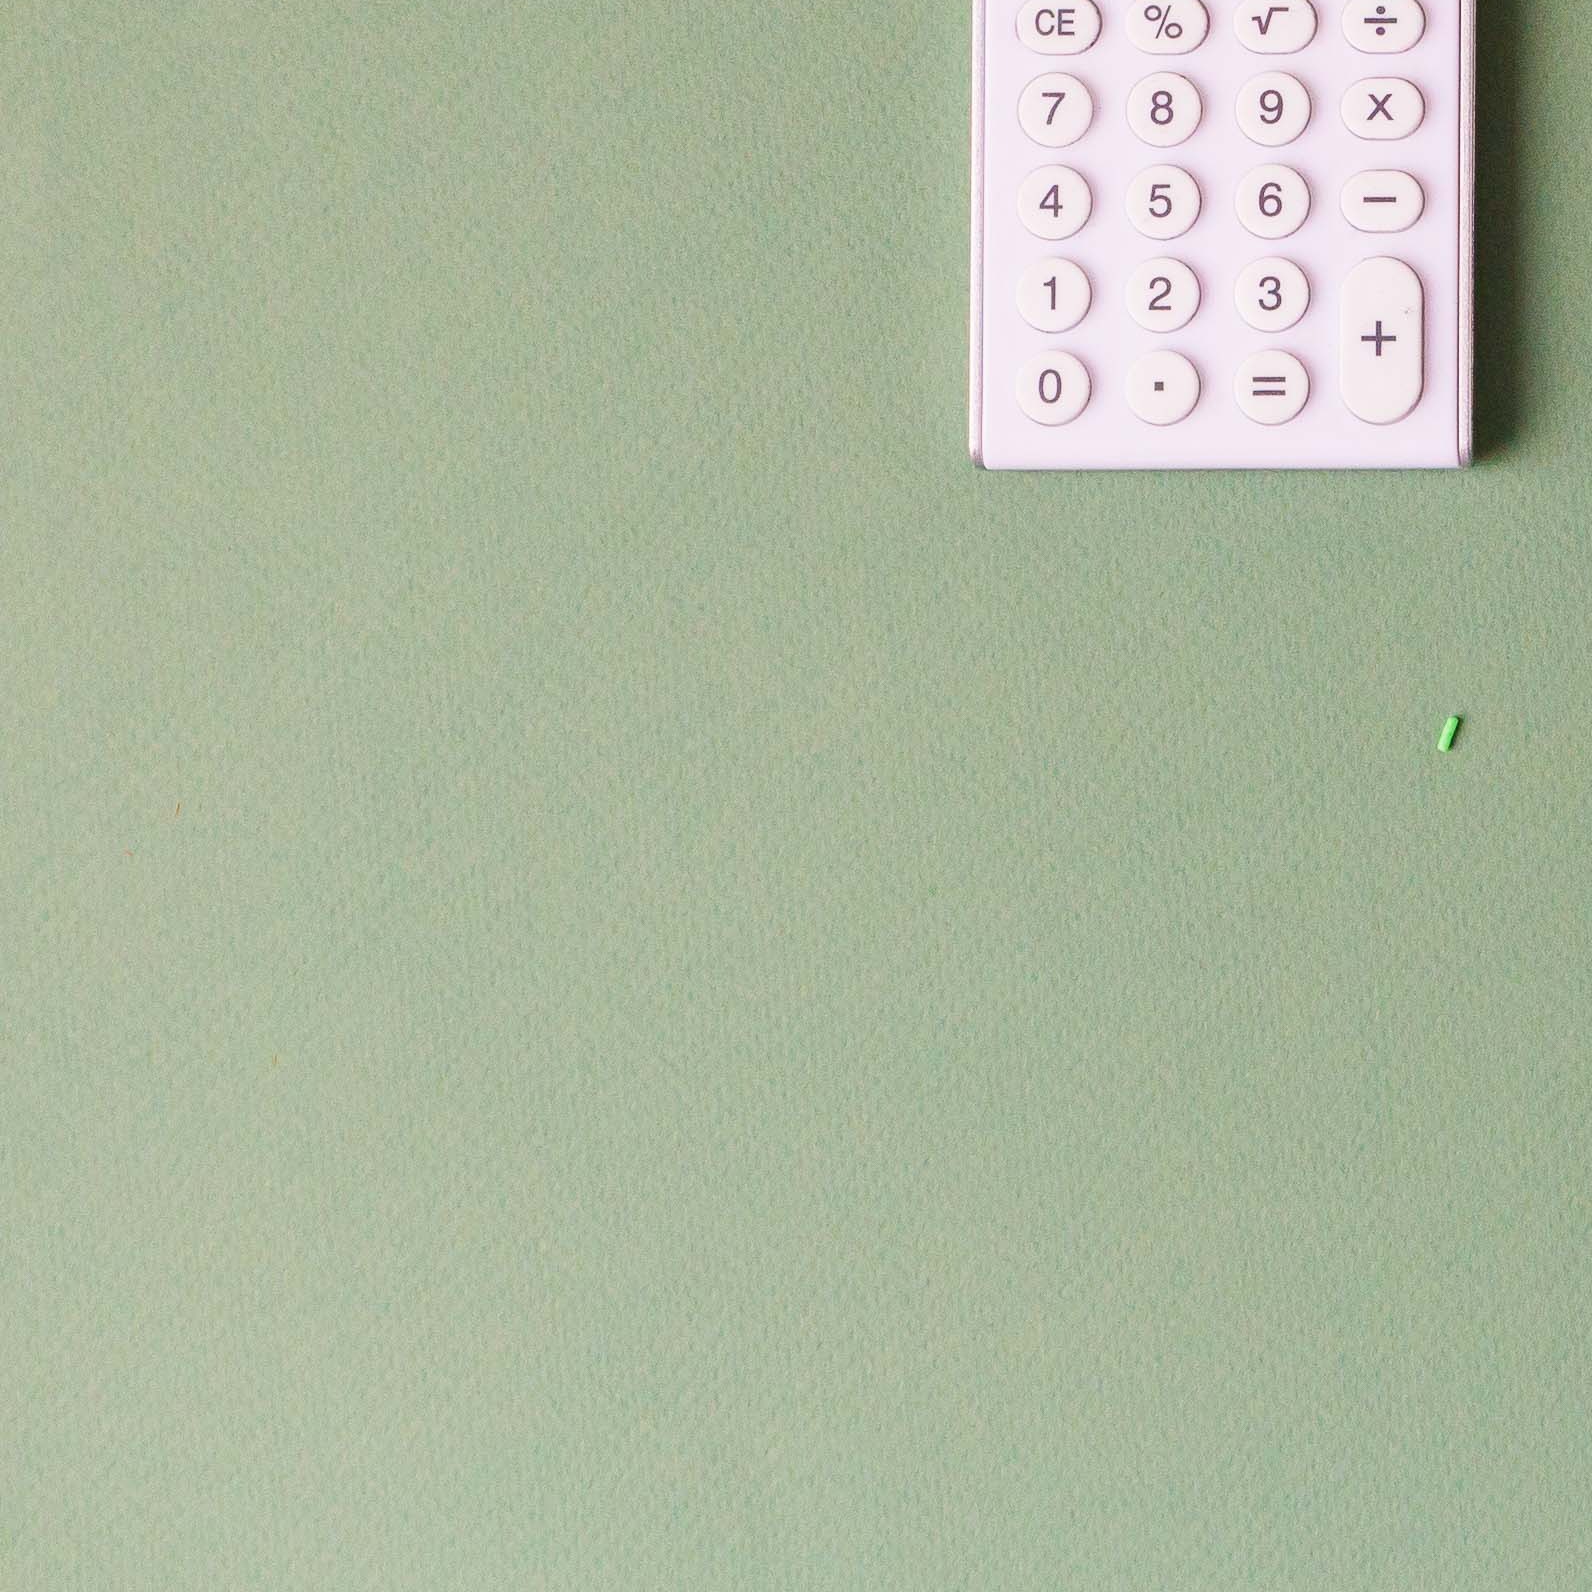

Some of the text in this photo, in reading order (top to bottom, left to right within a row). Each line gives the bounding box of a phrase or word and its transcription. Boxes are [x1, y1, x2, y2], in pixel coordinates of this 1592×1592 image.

[1034, 8, 1076, 37] CE
[1143, 4, 1183, 40] %
[1041, 92, 1066, 126] 7
[1149, 91, 1174, 126] 8
[1258, 89, 1284, 125] 9
[1039, 184, 1064, 218] 4
[1148, 184, 1173, 218] 5
[1258, 182, 1283, 218] 6
[1042, 276, 1058, 311] 1
[1148, 276, 1173, 311] 2
[1258, 275, 1283, 312] 3
[1038, 369, 1063, 404] 0
